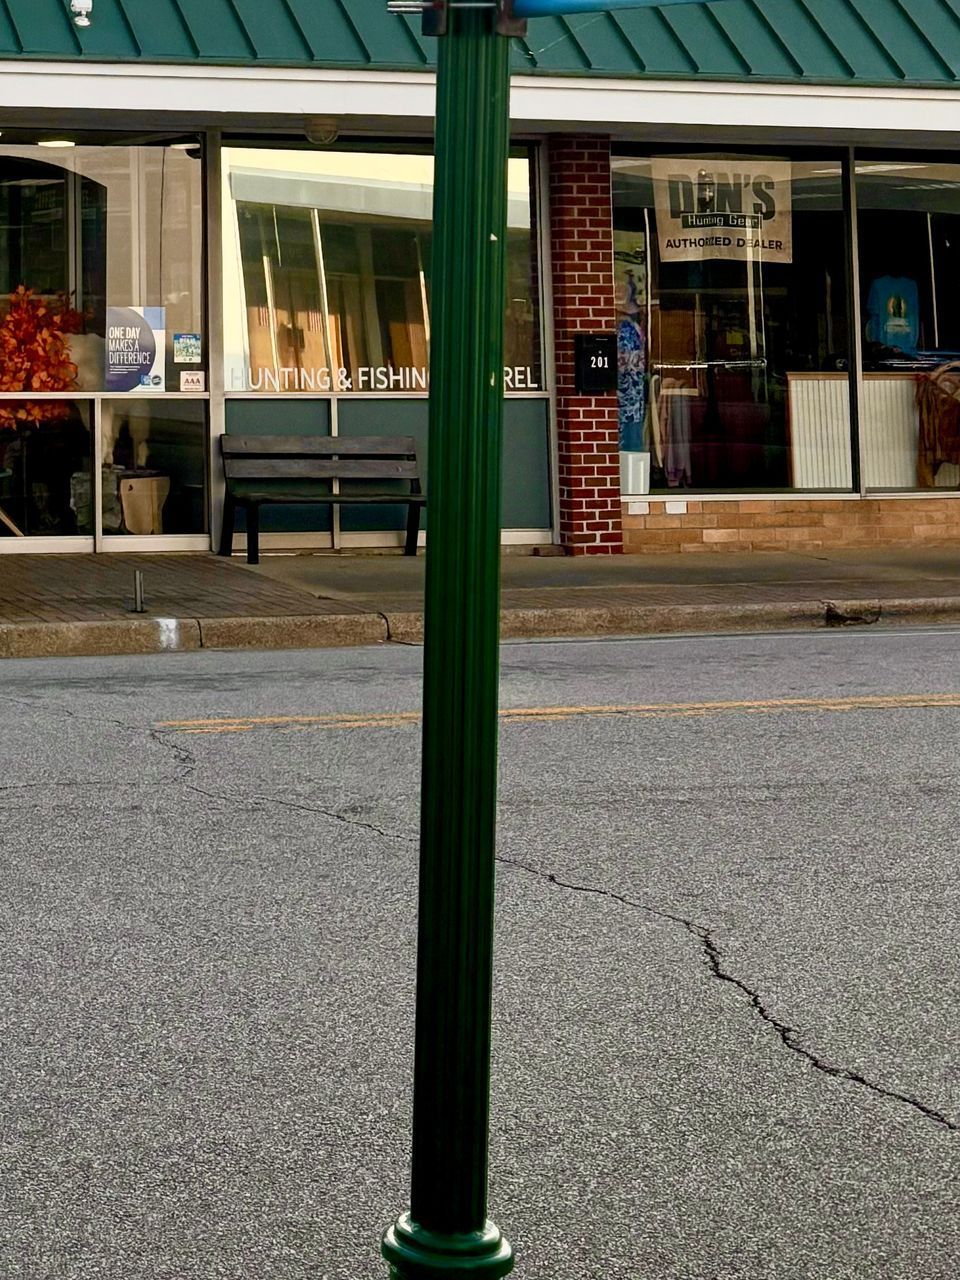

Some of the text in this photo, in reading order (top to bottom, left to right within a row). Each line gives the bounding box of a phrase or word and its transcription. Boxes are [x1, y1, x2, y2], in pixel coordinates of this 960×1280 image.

[108, 326, 141, 339] ONE DAY
[108, 339, 140, 352] MAKES A
[108, 351, 151, 365] DIFFERENCE
[590, 356, 609, 369] 201
[184, 377, 201, 385] AAA
[231, 366, 331, 390] HUNTING
[337, 366, 353, 390] &
[358, 366, 429, 390] FISHIN
